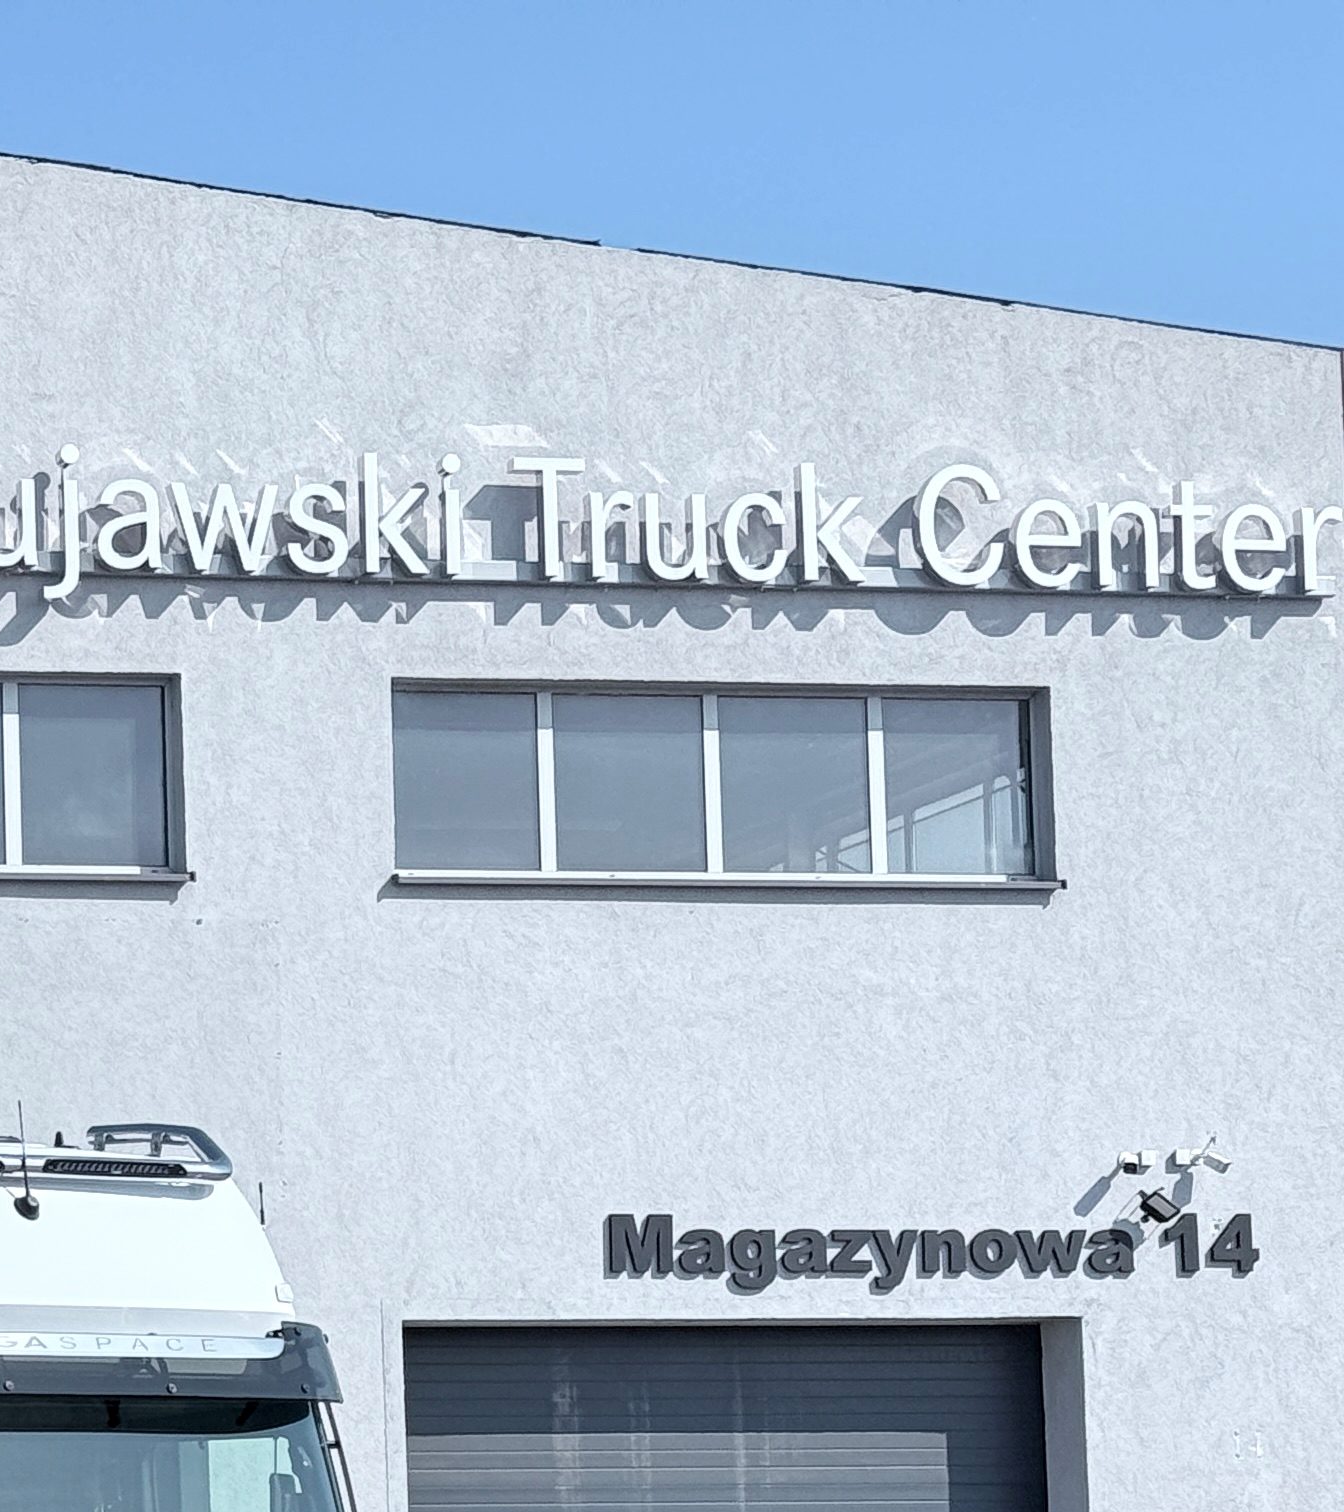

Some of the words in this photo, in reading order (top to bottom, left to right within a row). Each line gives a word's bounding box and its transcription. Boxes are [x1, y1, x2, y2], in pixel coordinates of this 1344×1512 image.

[512, 452, 870, 588] Truck
[912, 462, 1340, 594] Center
[605, 1213, 1134, 1294] Magazynowa
[1160, 1213, 1258, 1277] 14
